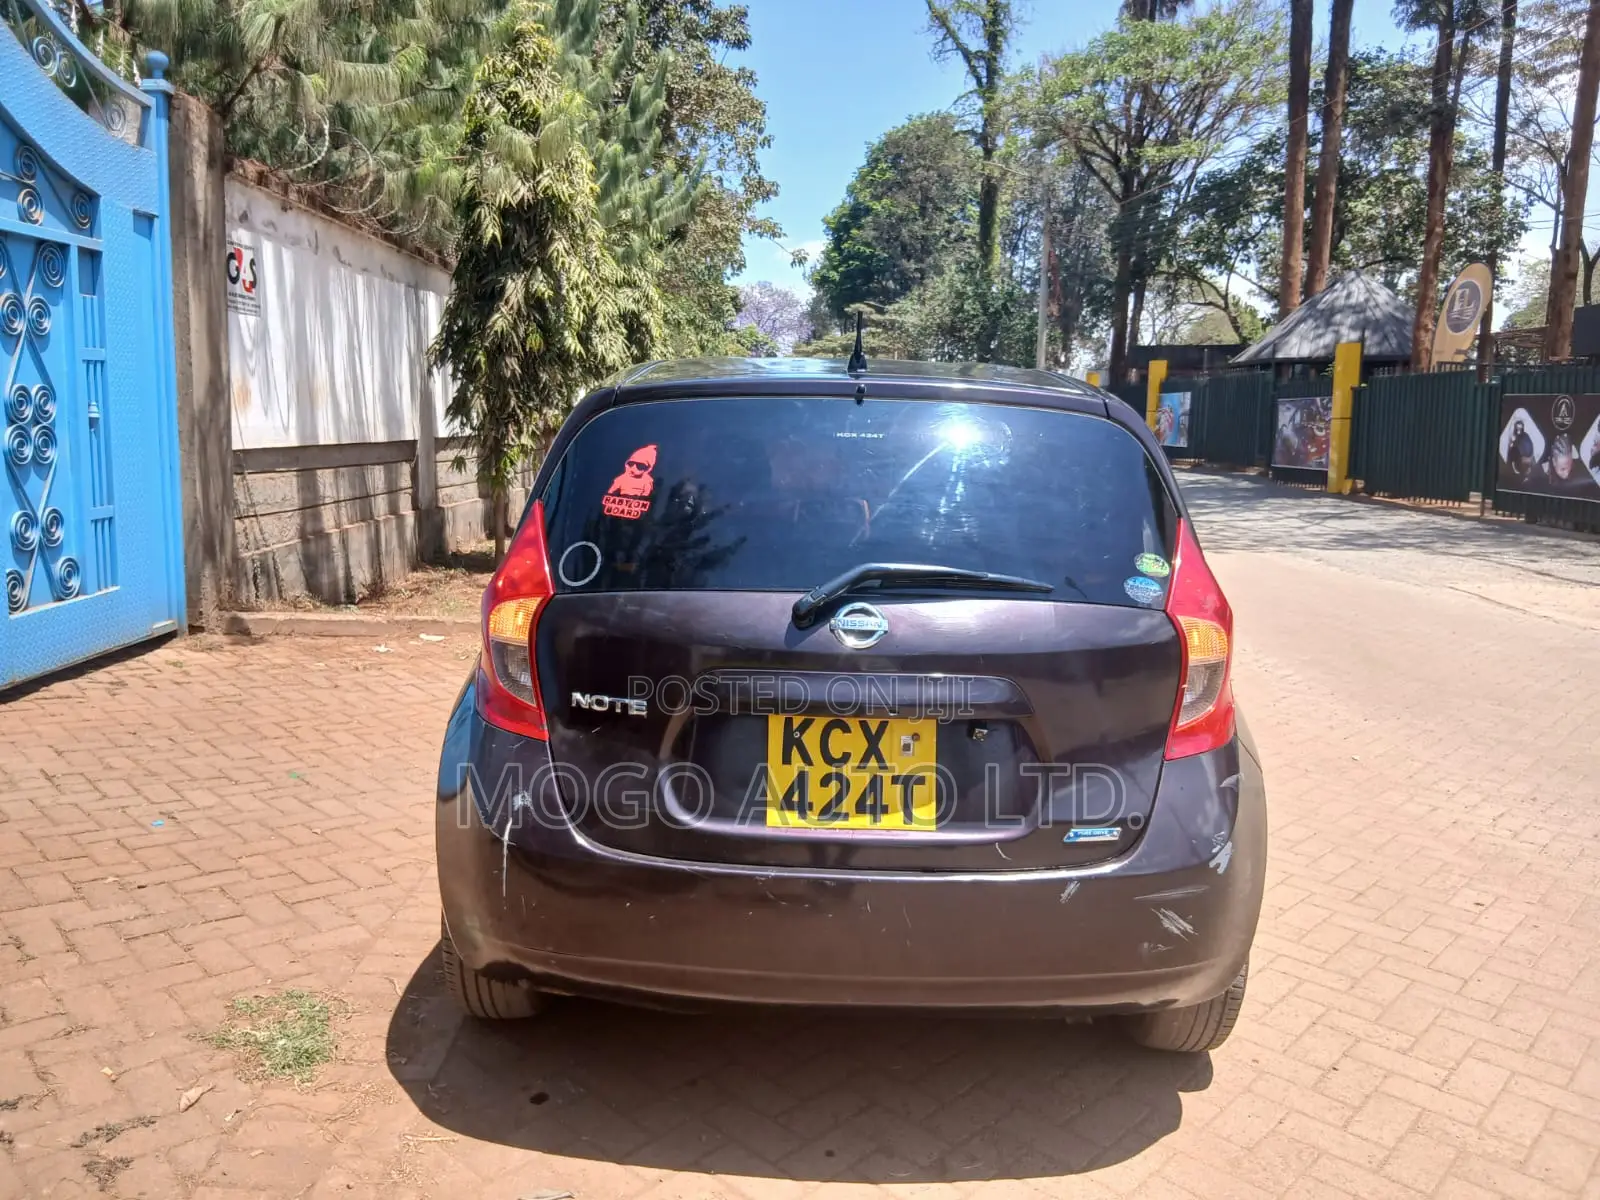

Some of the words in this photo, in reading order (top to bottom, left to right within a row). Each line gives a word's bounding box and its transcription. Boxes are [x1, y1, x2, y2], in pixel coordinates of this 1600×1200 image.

[837, 619, 883, 628] NISSAN
[571, 691, 648, 717] NOTE
[782, 717, 889, 770] KCX
[780, 769, 926, 826] 424T
